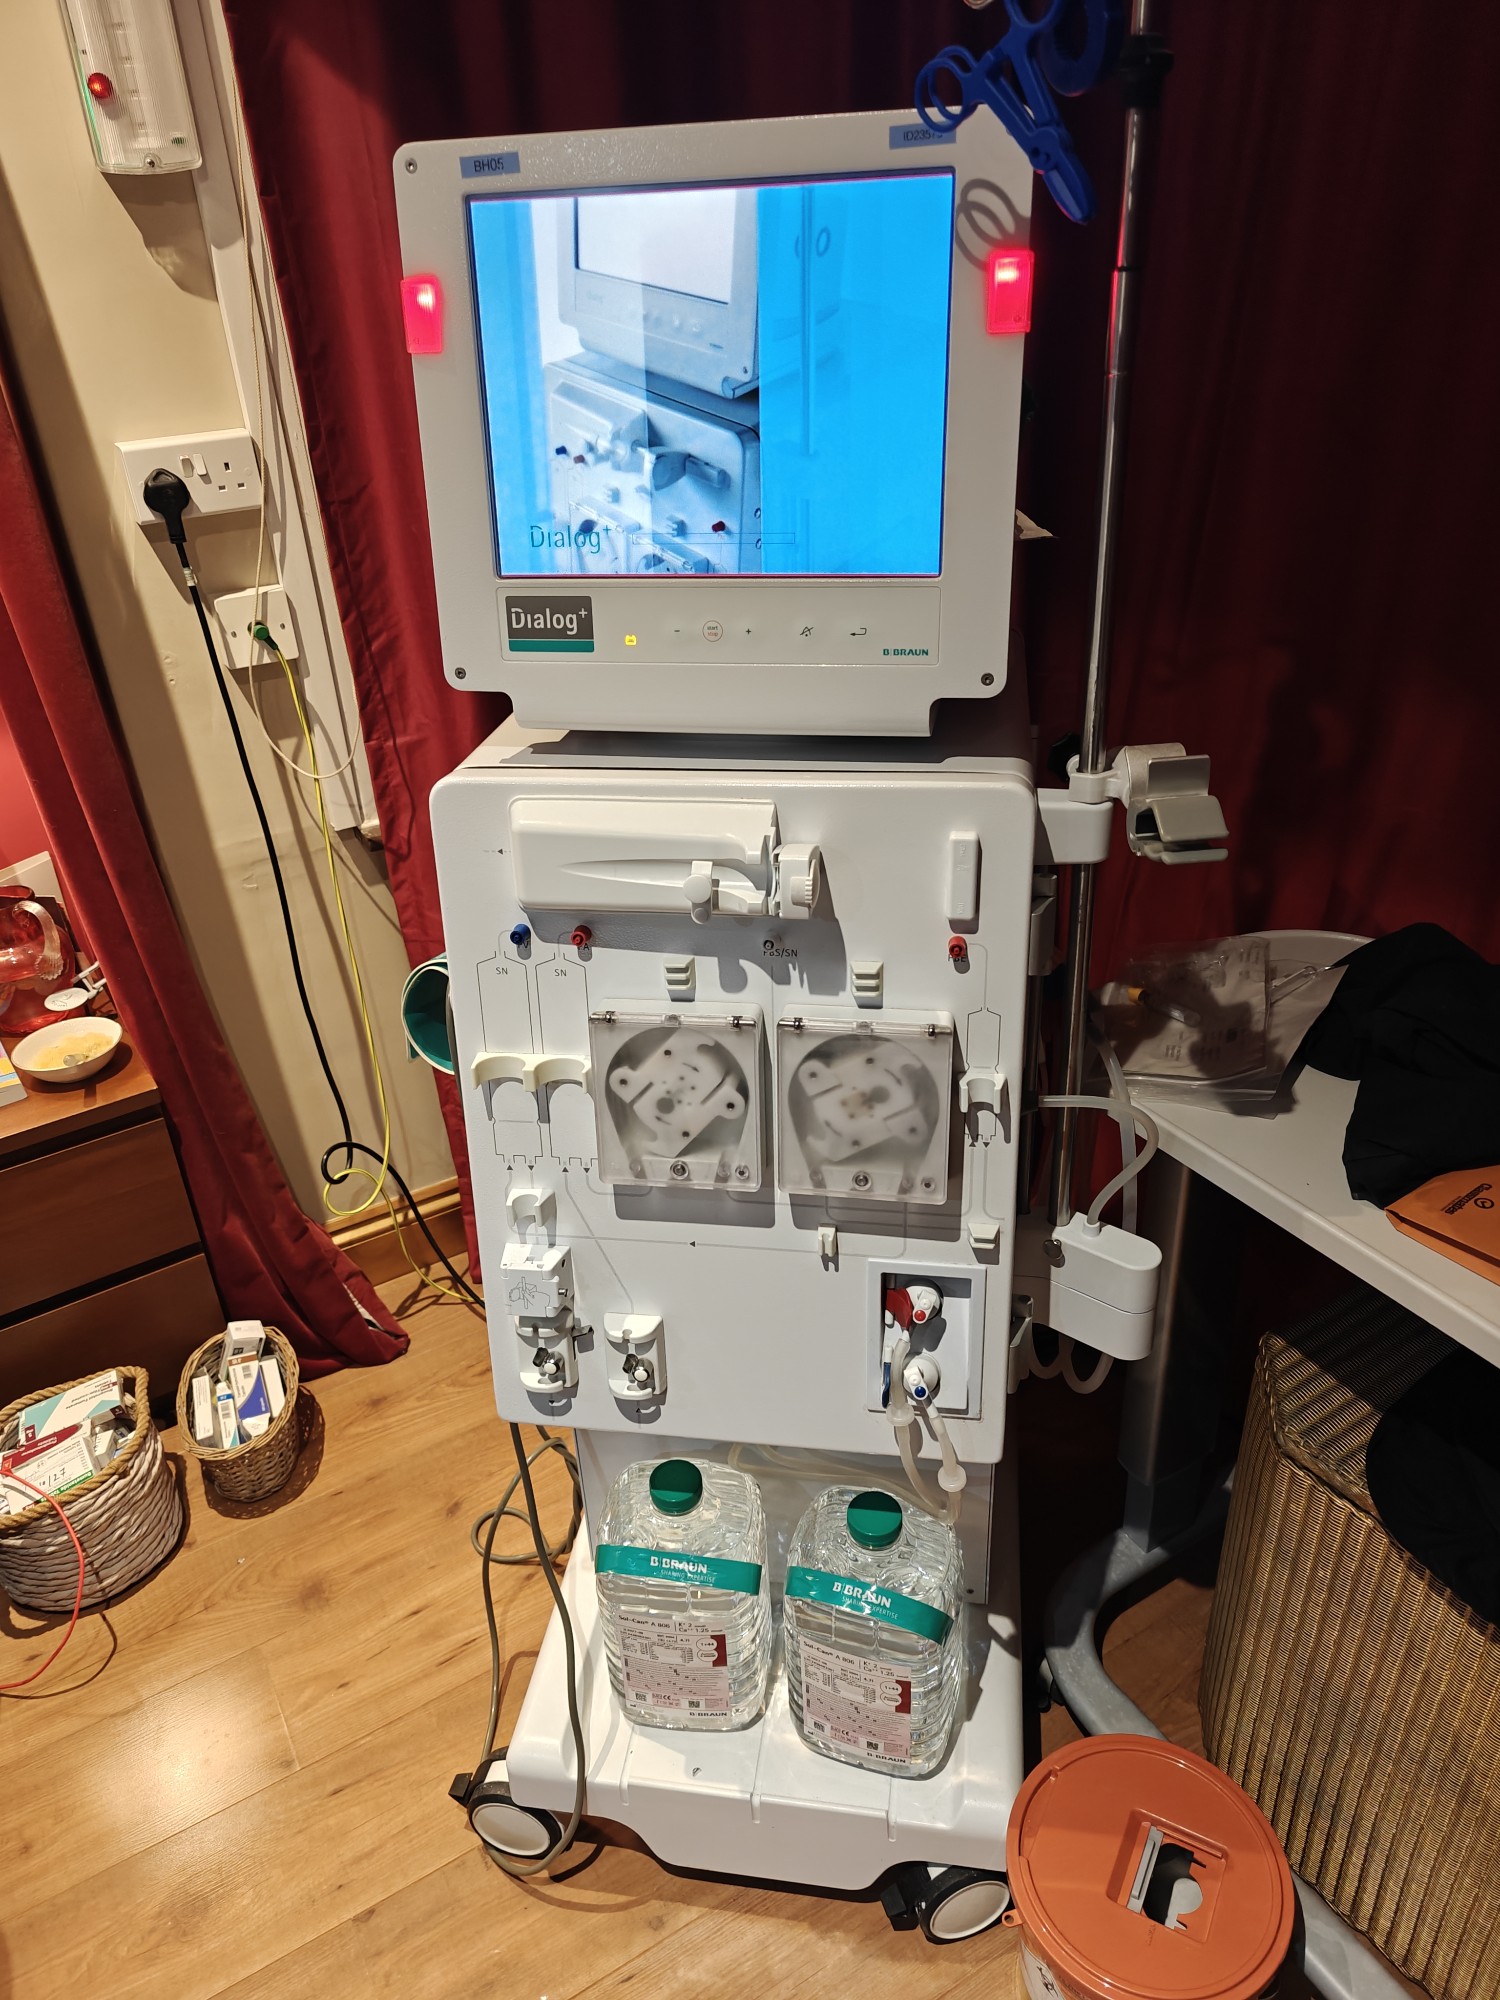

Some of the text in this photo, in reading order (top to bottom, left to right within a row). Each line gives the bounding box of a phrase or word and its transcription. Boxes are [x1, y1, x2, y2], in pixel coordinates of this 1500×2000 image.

[473, 157, 504, 173] BH05
[495, 967, 508, 975] SN
[554, 969, 567, 977] SN
